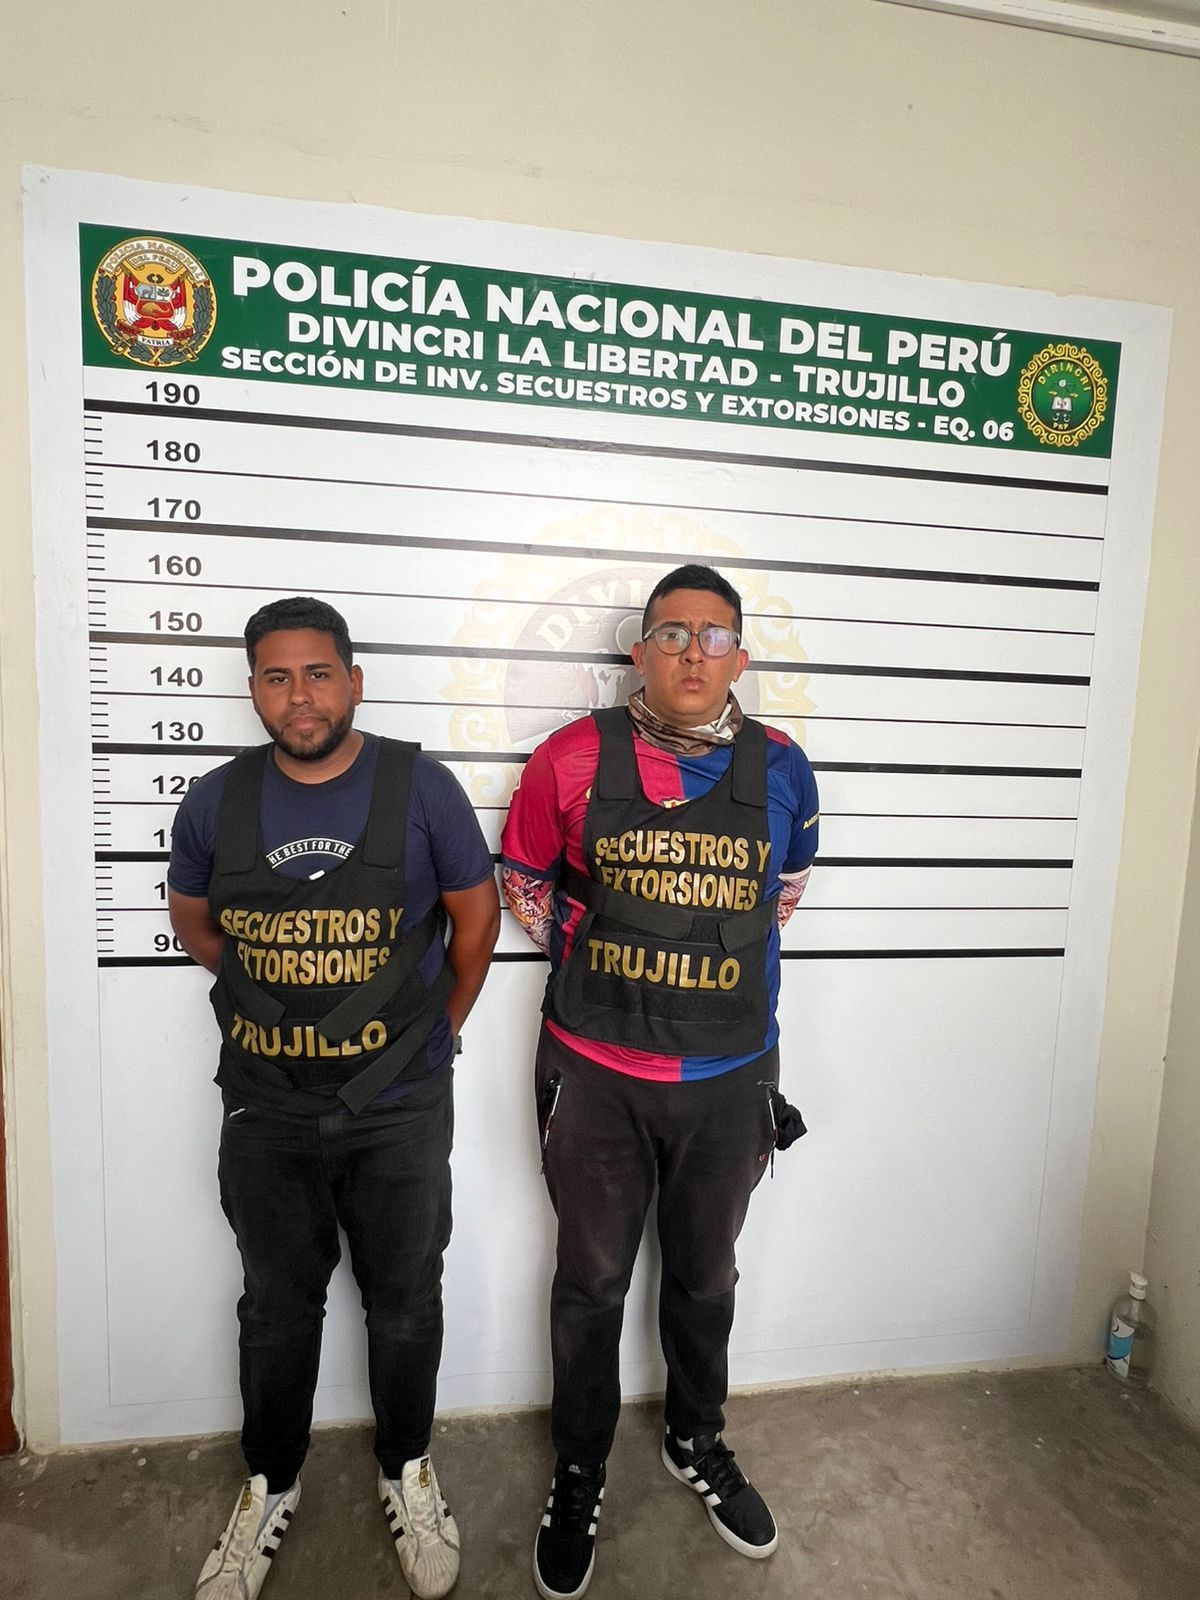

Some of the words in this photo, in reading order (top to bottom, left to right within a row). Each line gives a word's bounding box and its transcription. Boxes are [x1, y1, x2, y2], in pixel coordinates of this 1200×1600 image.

[233, 256, 471, 320] POLICÍA
[487, 284, 765, 351] NACIONAL
[779, 318, 873, 362] DEL
[887, 333, 1012, 377] PERÚ
[141, 337, 171, 346] PATRIA
[288, 312, 484, 361] DIVINCRI
[498, 333, 552, 367] LA
[564, 340, 759, 387] LIBERTAD
[769, 373, 782, 383] -
[793, 364, 966, 408] TRUJILLO
[1037, 362, 1091, 391] DIRINCRI
[145, 381, 200, 405] 190
[221, 346, 365, 381] SECCIÓN
[375, 360, 417, 386] DE
[427, 364, 489, 392] INV.
[497, 372, 688, 410] SECUESTROS
[695, 391, 715, 412] Y
[721, 394, 911, 432] EXTORSIONES
[934, 415, 976, 442] EQ.
[982, 419, 1014, 442] 06
[1053, 422, 1069, 430] PNP
[146, 439, 201, 463] 180
[147, 497, 202, 520] 170
[148, 554, 202, 577] 160
[149, 610, 203, 632] 150
[150, 666, 203, 687] 140
[151, 721, 204, 742] 130
[268, 851, 283, 865] HE
[283, 841, 309, 857] BEST
[312, 840, 331, 851] FOR
[334, 843, 353, 857] THE
[595, 830, 749, 871] SECUESTROS
[756, 840, 772, 872] Y
[601, 866, 758, 911] EXTORSIONES
[220, 908, 381, 944] SECUESTROS
[389, 908, 404, 939] Y
[588, 939, 741, 990] TRUJILLO
